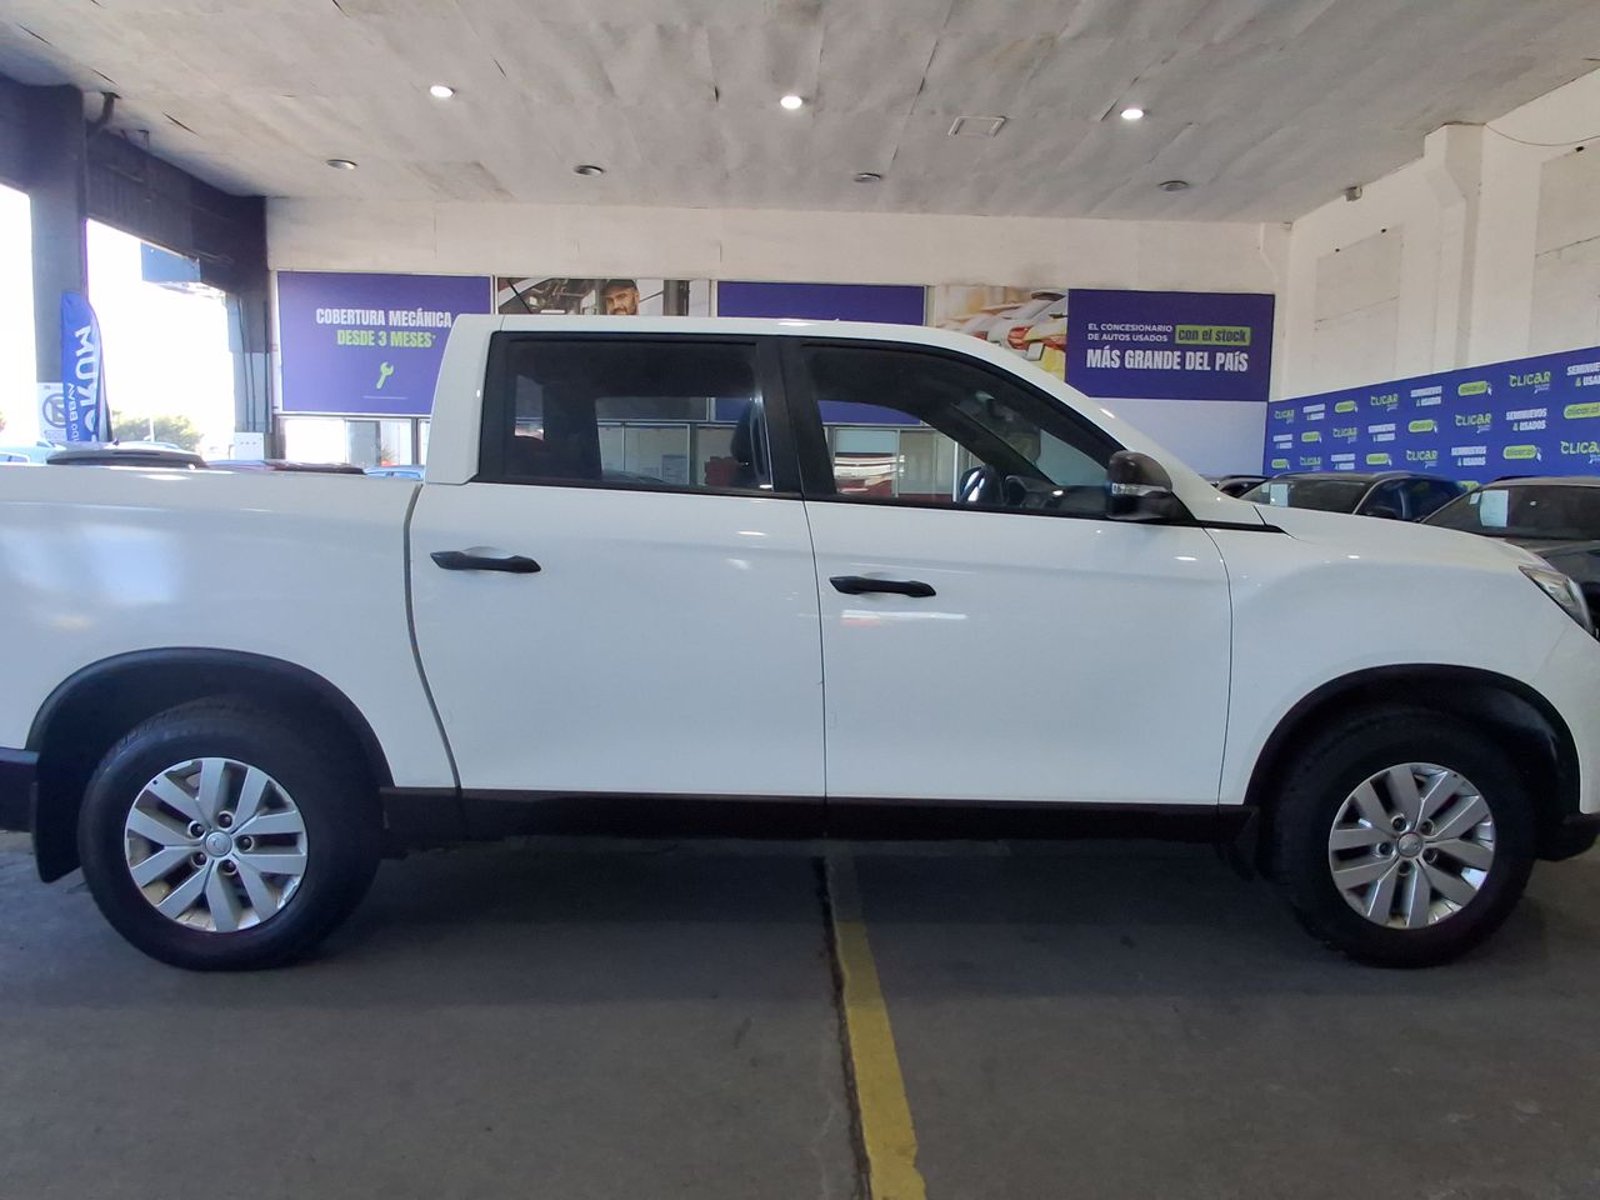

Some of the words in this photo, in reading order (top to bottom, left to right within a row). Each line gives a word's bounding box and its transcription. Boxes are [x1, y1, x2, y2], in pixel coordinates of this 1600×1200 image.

[316, 308, 385, 326] COBERTURA
[389, 307, 452, 328] MECÁNICA
[1088, 323, 1099, 331] EL
[1100, 323, 1173, 333] CONCESIONARIO
[1178, 329, 1199, 341] con
[1202, 328, 1212, 341] el
[1215, 329, 1247, 343] stock
[337, 329, 375, 346] DESDE
[378, 330, 387, 346] 3
[1087, 333, 1099, 341] DE
[1101, 333, 1131, 342] AUTOS
[1132, 334, 1169, 342] USADOS
[1086, 345, 1121, 368] MÁS
[1125, 349, 1181, 370] GRANDE
[1185, 351, 1211, 371] DEL
[1215, 351, 1249, 372] PAÍS
[1560, 441, 1600, 454] CLICA
